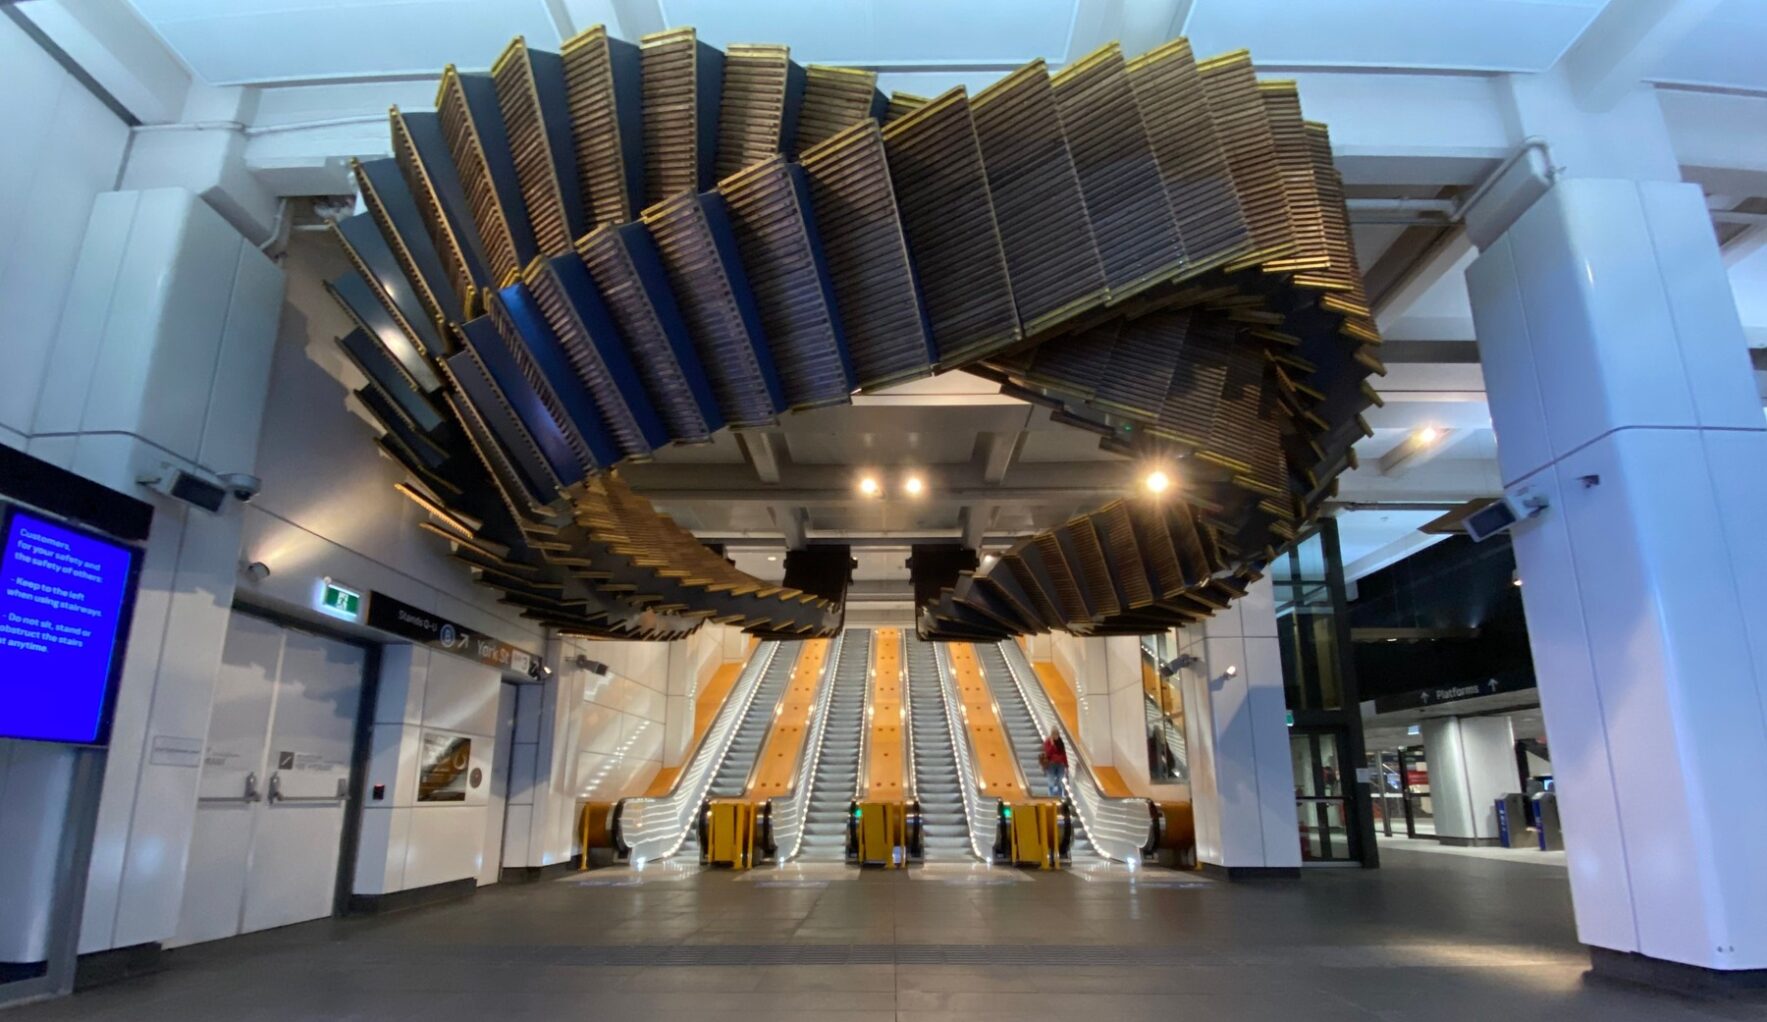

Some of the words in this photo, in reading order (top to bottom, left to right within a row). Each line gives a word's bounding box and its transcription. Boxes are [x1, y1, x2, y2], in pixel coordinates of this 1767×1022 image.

[14, 552, 31, 563] the
[32, 558, 61, 573] safety
[62, 566, 73, 574] of
[17, 540, 32, 550] for
[32, 546, 55, 557] your
[55, 552, 84, 567] safety
[84, 561, 101, 571] and
[6, 588, 33, 600] when
[34, 595, 60, 609] using
[16, 577, 41, 591] Keep
[41, 584, 52, 593] to
[53, 587, 69, 597] the
[69, 591, 85, 601] left
[8, 612, 22, 623] Do
[22, 616, 40, 627] not
[55, 624, 82, 636] stand
[82, 630, 92, 638] or
[41, 632, 58, 643] the
[58, 636, 84, 648] stairs
[1436, 685, 1480, 700] Platforms
